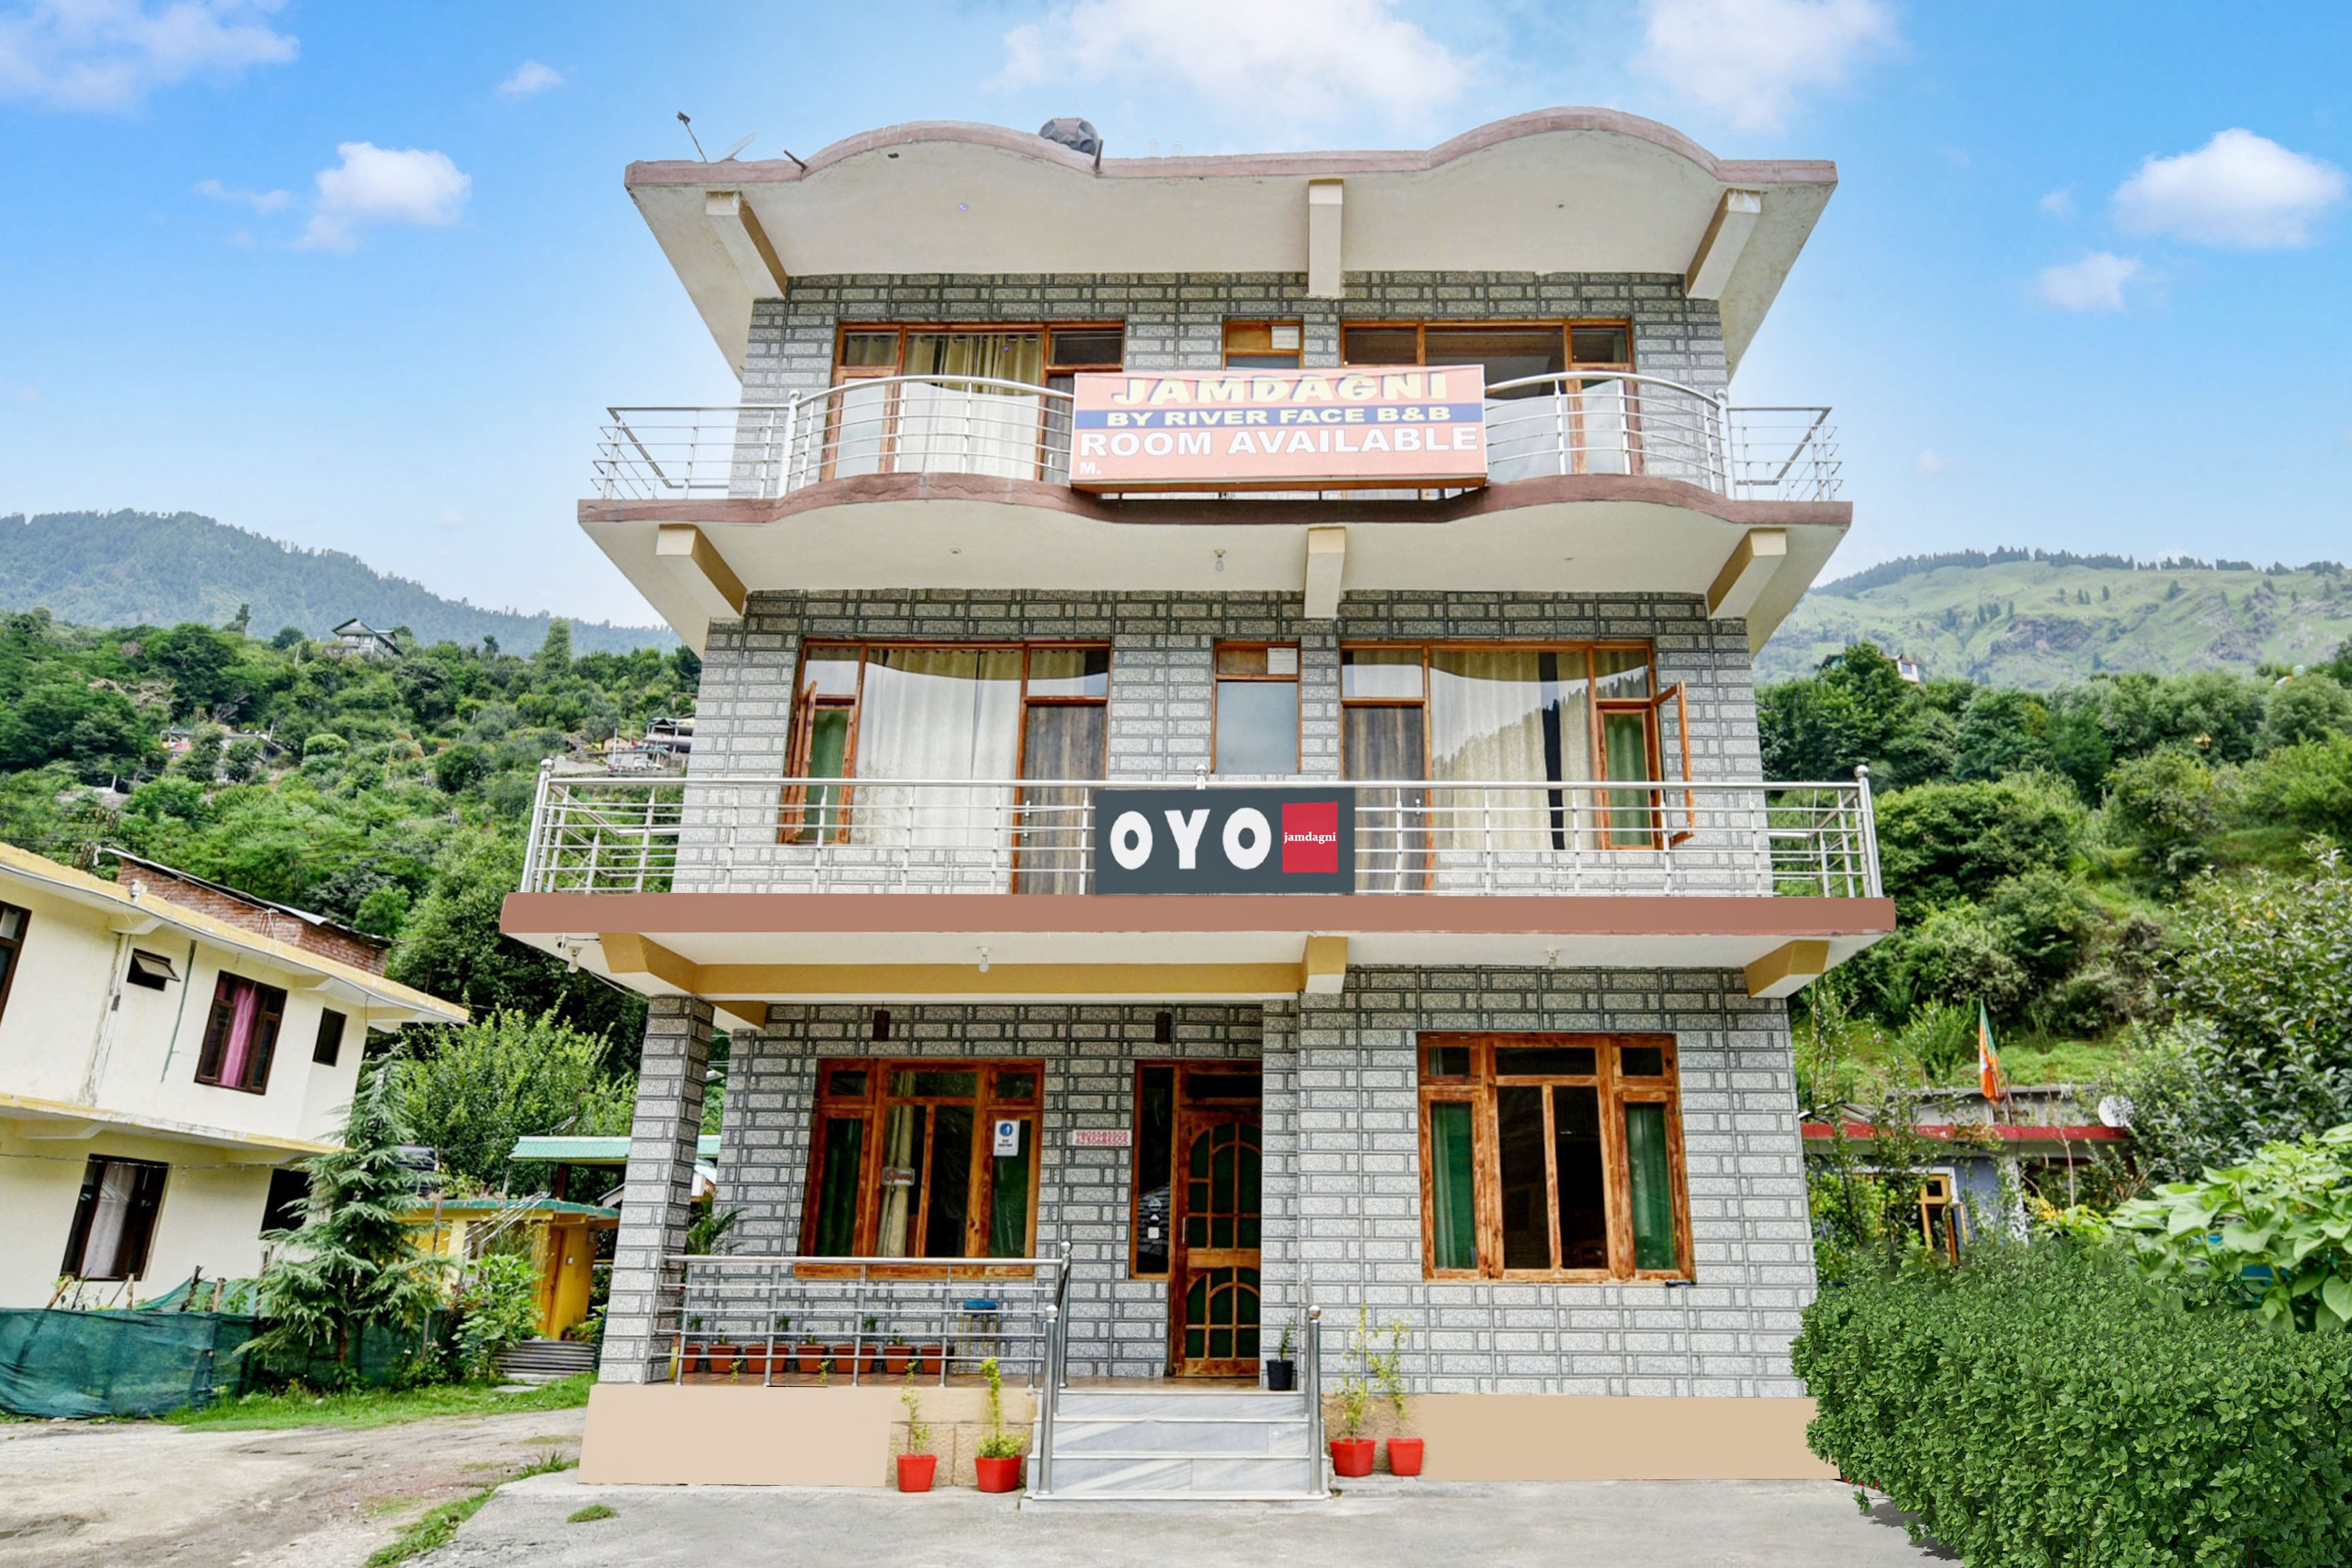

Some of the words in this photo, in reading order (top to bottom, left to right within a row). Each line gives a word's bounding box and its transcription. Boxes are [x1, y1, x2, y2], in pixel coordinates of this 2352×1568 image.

[1111, 372, 1448, 405] JAMDAGNI
[1107, 412, 1154, 427] BY
[1164, 410, 1268, 426] RIVER
[1279, 408, 1365, 424] FACE
[1377, 406, 1452, 422] B&B
[1079, 431, 1212, 457] ROOM
[1227, 427, 1479, 455] AVAILABLE
[1109, 807, 1272, 870] OYO
[1284, 831, 1336, 844] jamdagni
